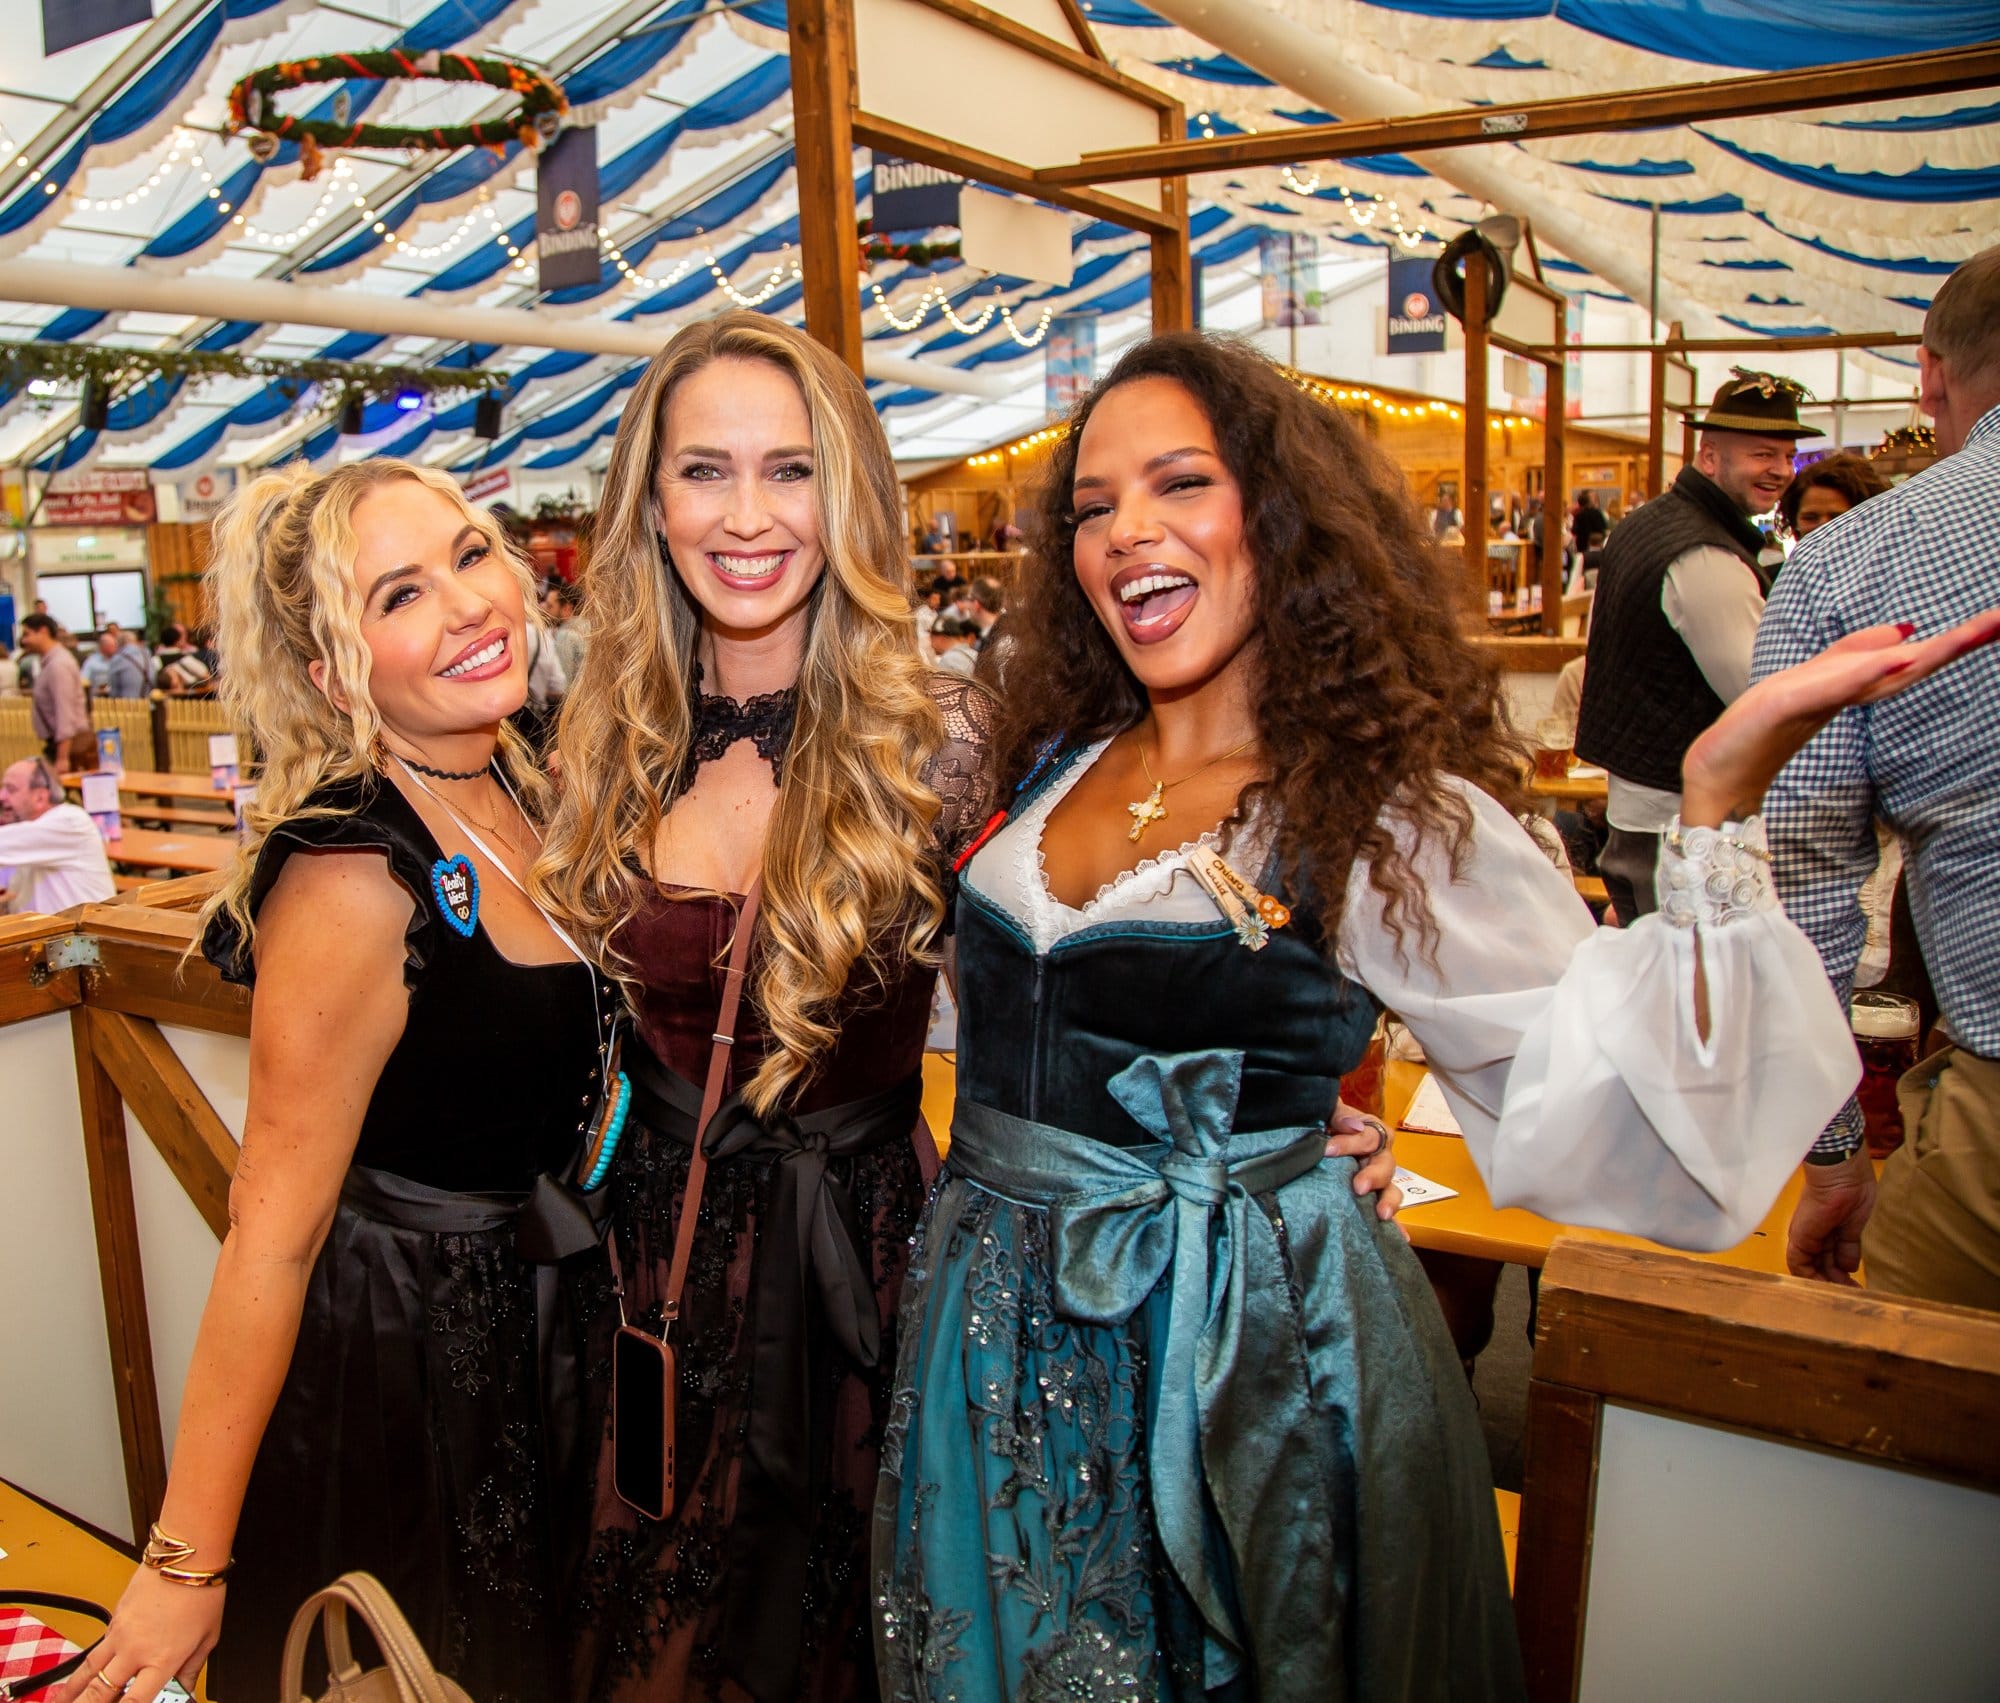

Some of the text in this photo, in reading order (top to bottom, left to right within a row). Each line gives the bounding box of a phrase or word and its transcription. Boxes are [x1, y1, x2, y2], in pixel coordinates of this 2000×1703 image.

[539, 224, 598, 258] BINDING
[1390, 314, 1444, 335] BINDING
[1212, 859, 1244, 891] Chiara
